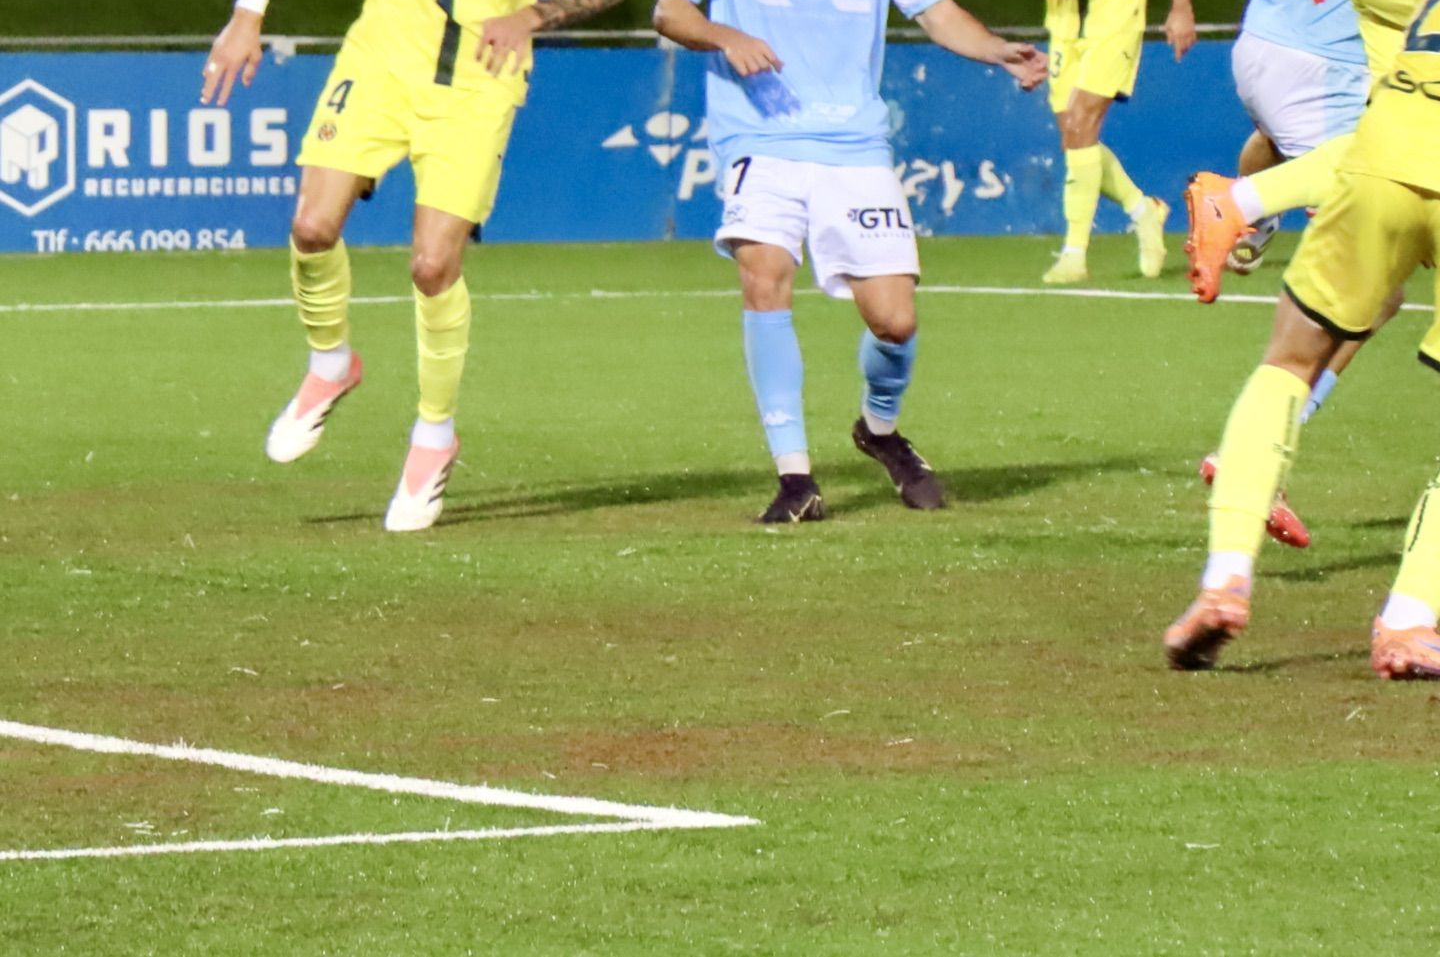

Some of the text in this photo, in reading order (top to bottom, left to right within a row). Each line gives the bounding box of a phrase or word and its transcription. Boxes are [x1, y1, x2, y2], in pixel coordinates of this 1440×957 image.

[327, 78, 354, 115] 4
[87, 108, 289, 167] RIOS
[84, 176, 296, 198] RECUPERACIONES
[859, 207, 910, 231] GTL
